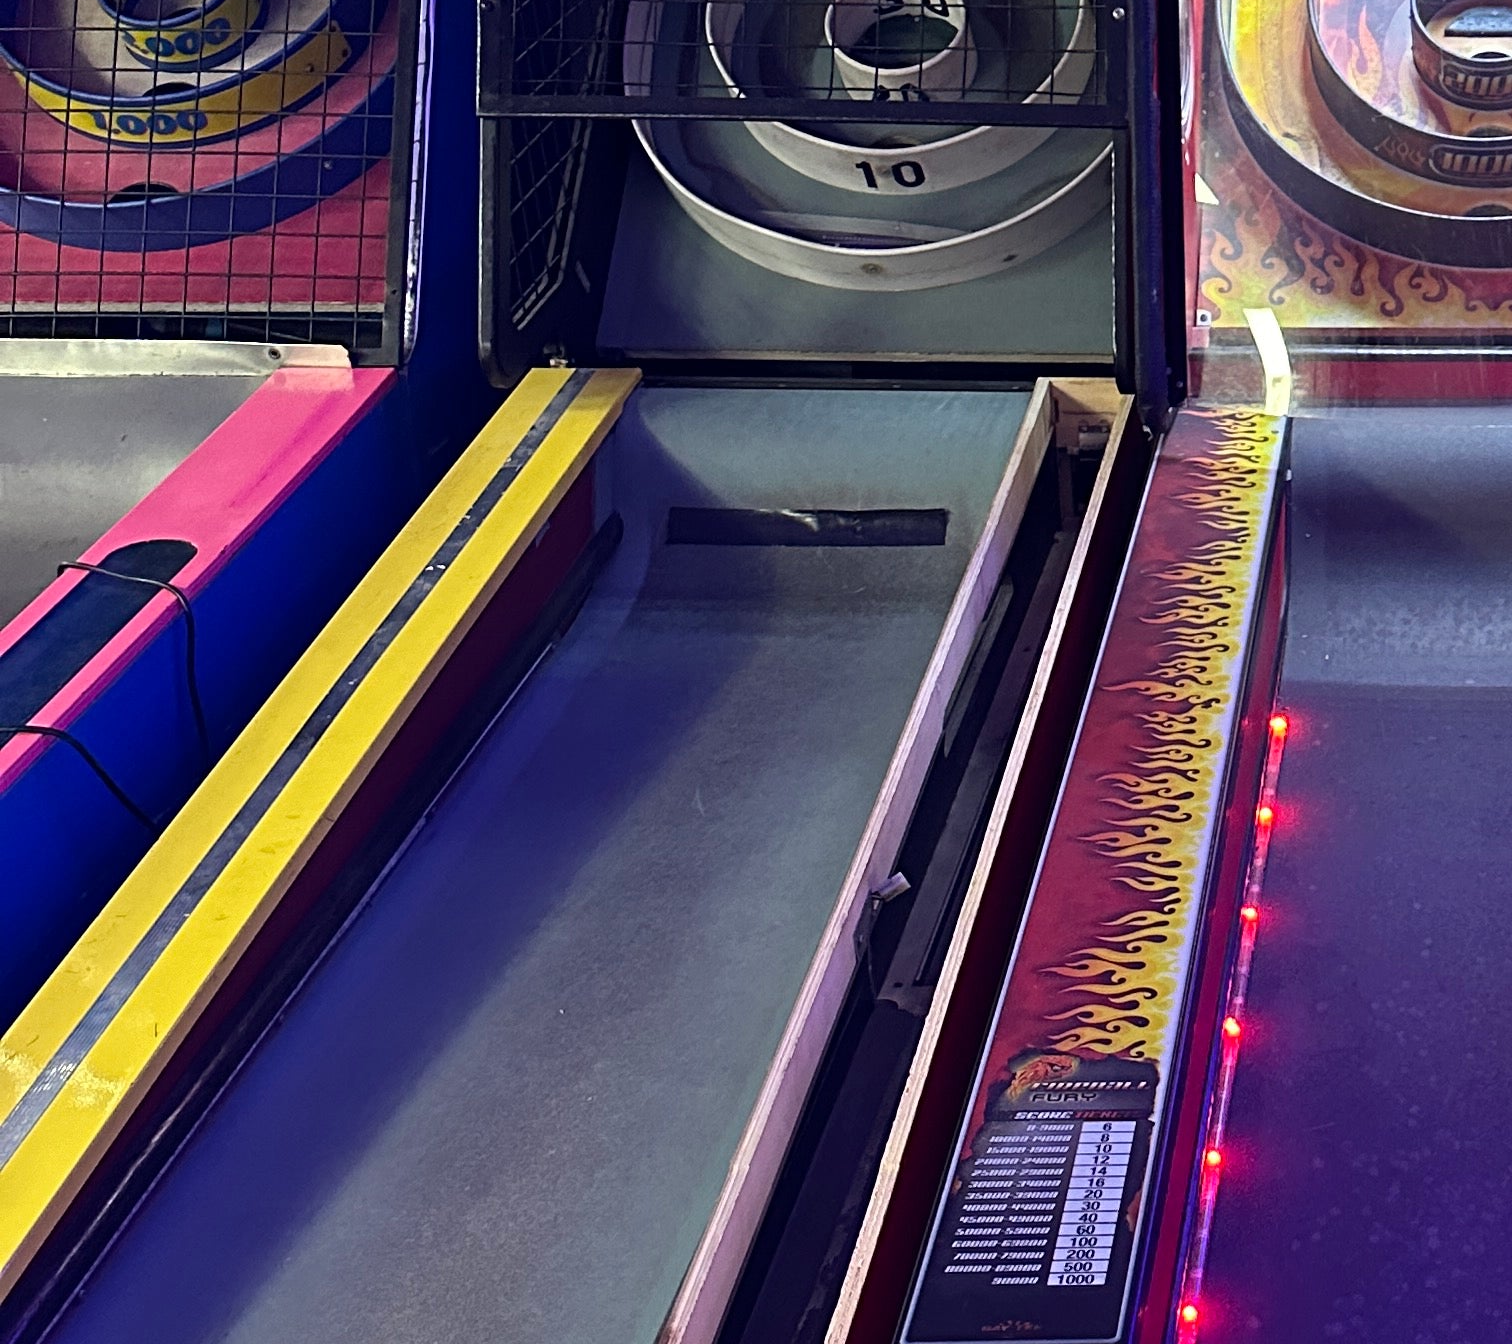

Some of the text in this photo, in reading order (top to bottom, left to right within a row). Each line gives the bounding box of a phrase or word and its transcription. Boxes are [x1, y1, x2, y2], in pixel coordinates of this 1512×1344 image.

[855, 160, 926, 189] 10
[1031, 1092, 1098, 1103] FURY
[1095, 1144, 1113, 1153] 10
[1092, 1156, 1111, 1165] 12
[1090, 1167, 1108, 1176] 14
[1084, 1189, 1103, 1199] 20
[1081, 1201, 1100, 1211] 30
[1078, 1213, 1098, 1223] 40
[1076, 1225, 1096, 1235] 60
[1071, 1237, 1098, 1247] 100
[1066, 1249, 1095, 1260] 200
[1064, 1261, 1093, 1272] 500
[1057, 1274, 1095, 1285] 1000
